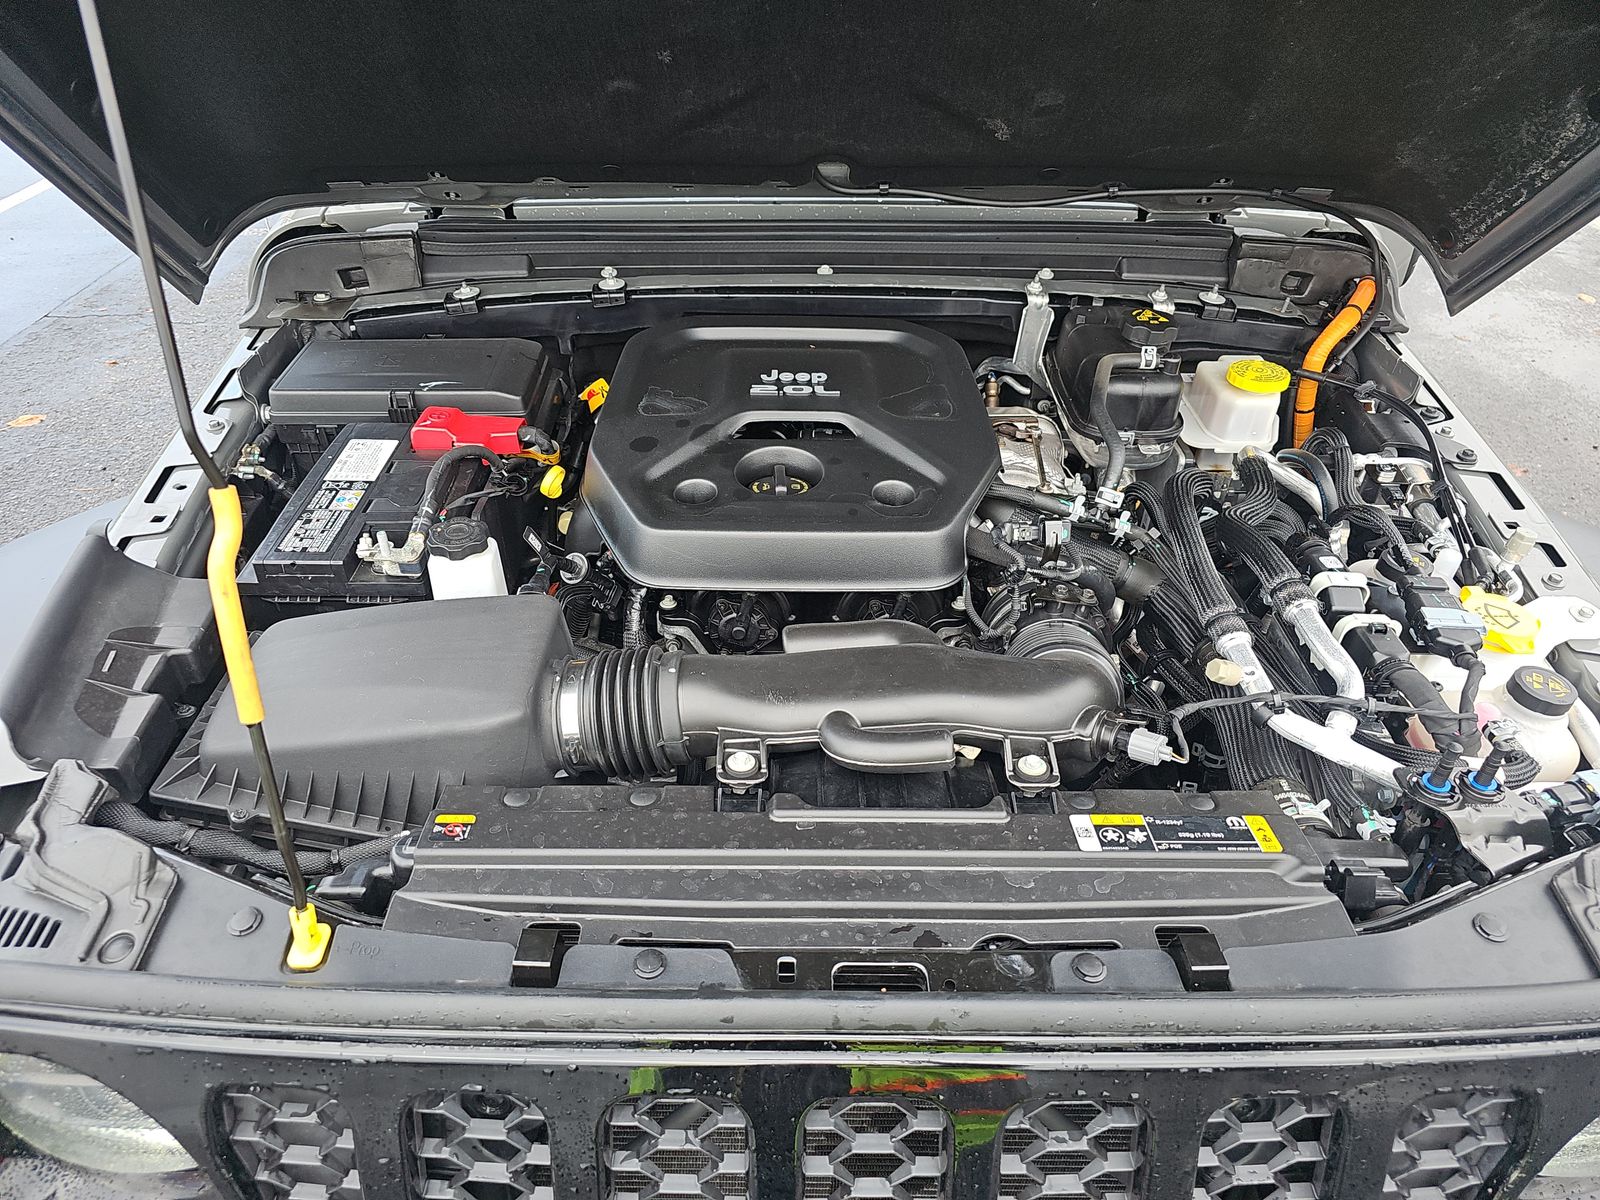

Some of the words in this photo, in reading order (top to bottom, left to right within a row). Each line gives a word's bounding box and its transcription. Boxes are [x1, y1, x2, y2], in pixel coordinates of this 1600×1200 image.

[760, 369, 828, 384] Jeep
[750, 385, 841, 397] 2.0L
[350, 940, 381, 960] Prop
